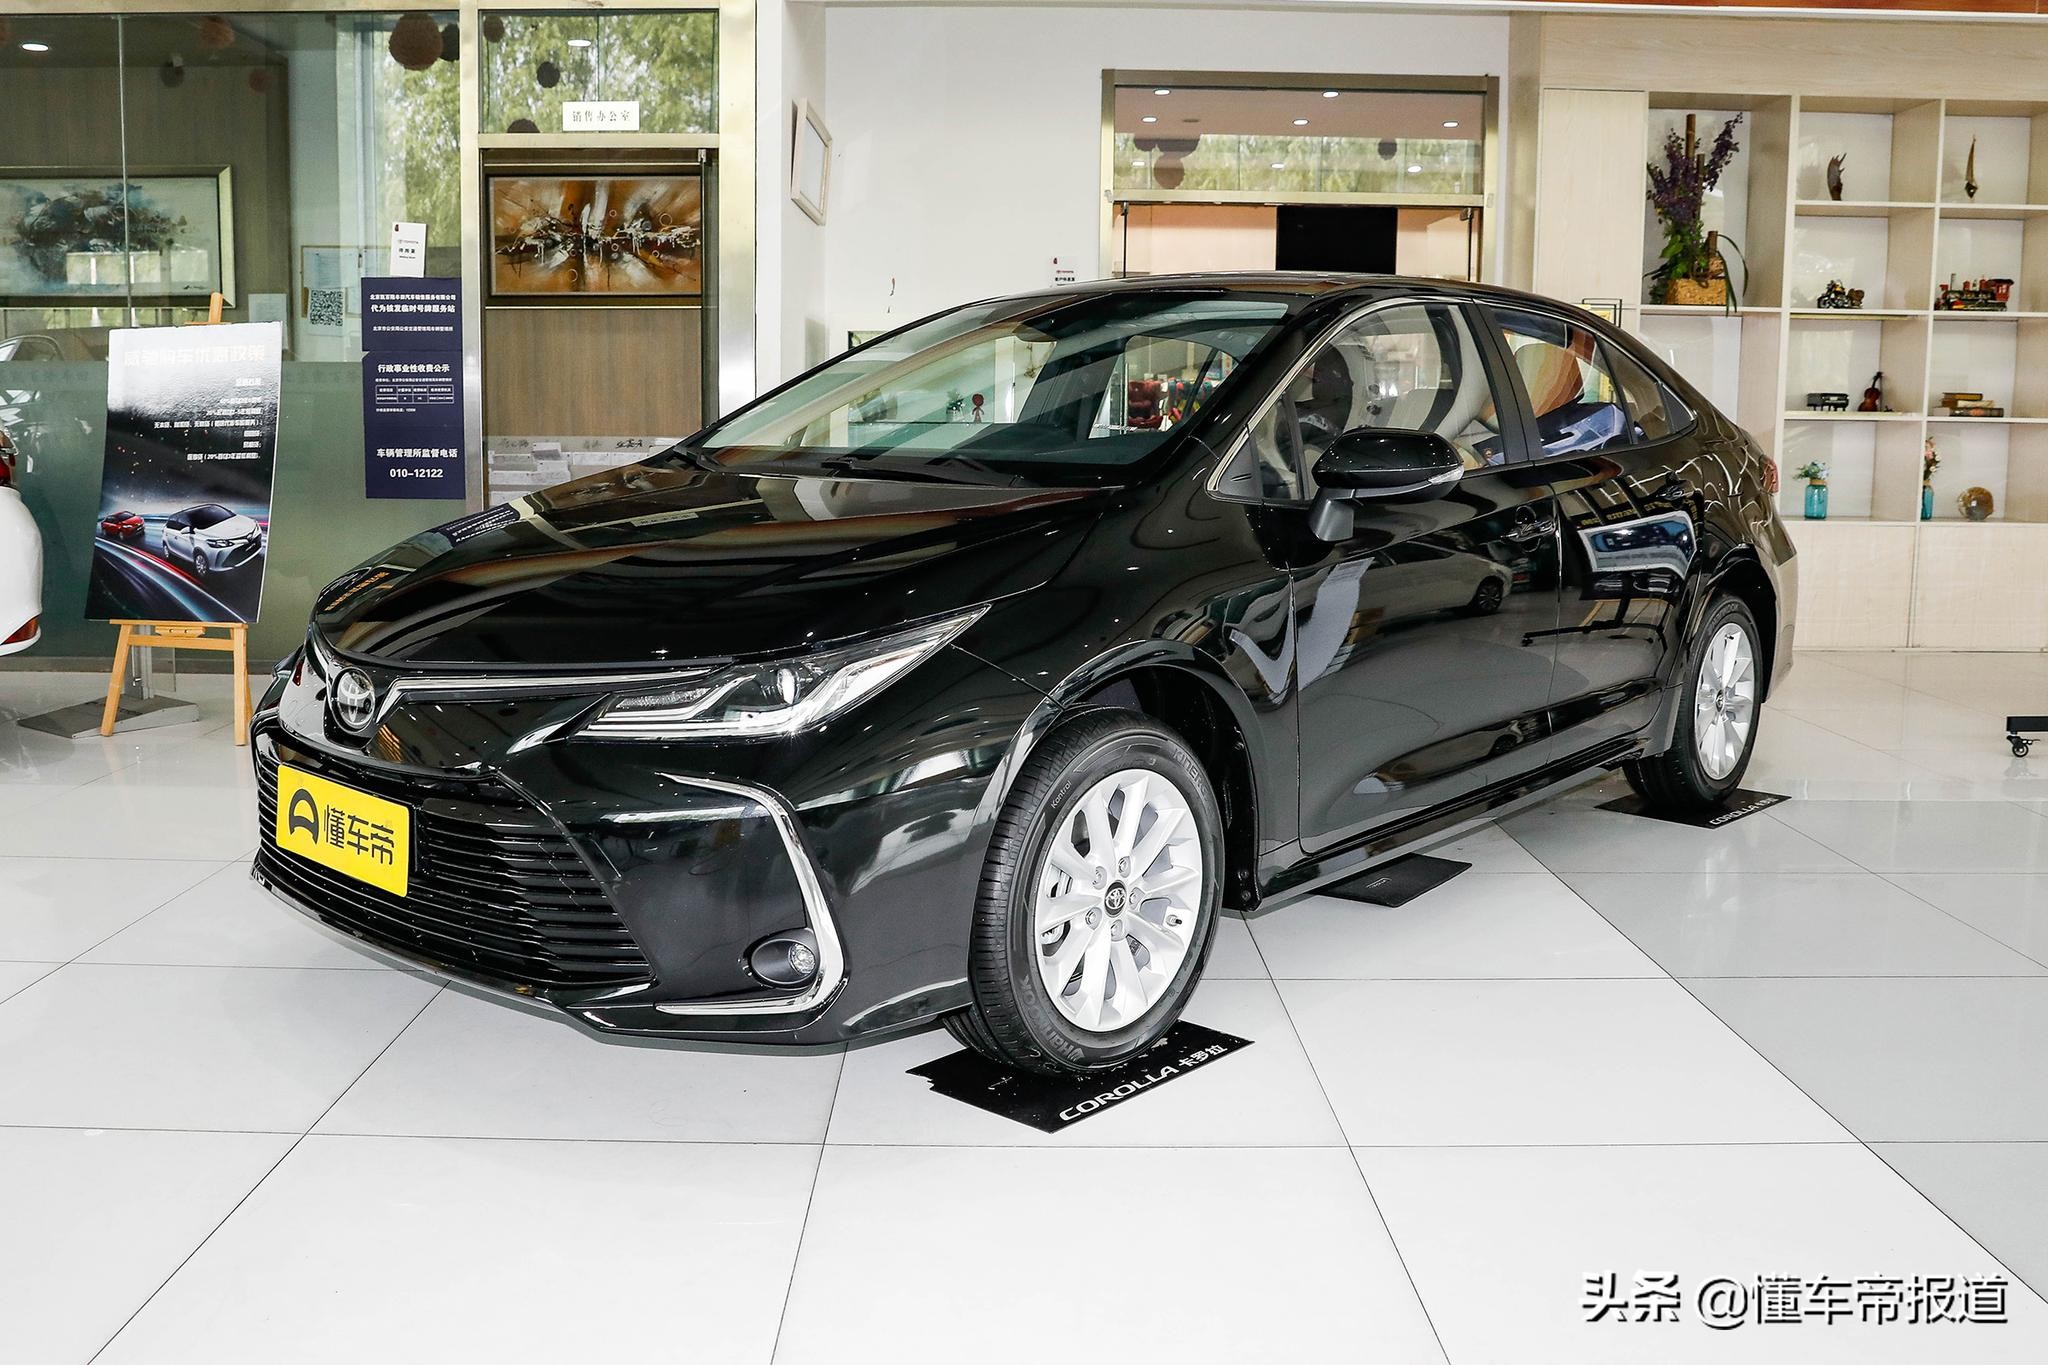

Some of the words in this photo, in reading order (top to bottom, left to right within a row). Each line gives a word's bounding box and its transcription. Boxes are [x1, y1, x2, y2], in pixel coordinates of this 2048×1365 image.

[572, 110, 631, 122] 销售办公室
[371, 304, 456, 313] 代为核发临时号牌服务站
[377, 363, 450, 373] 行政事业性收费公示
[376, 448, 458, 458] 车辆管理所监督电话
[389, 468, 443, 478] 010-12122
[1050, 780, 1072, 809] Kontrol
[323, 804, 395, 866] 懂车帝
[1059, 1065, 1180, 1121] COROLLA
[1178, 1044, 1228, 1067] 卡罗拉
